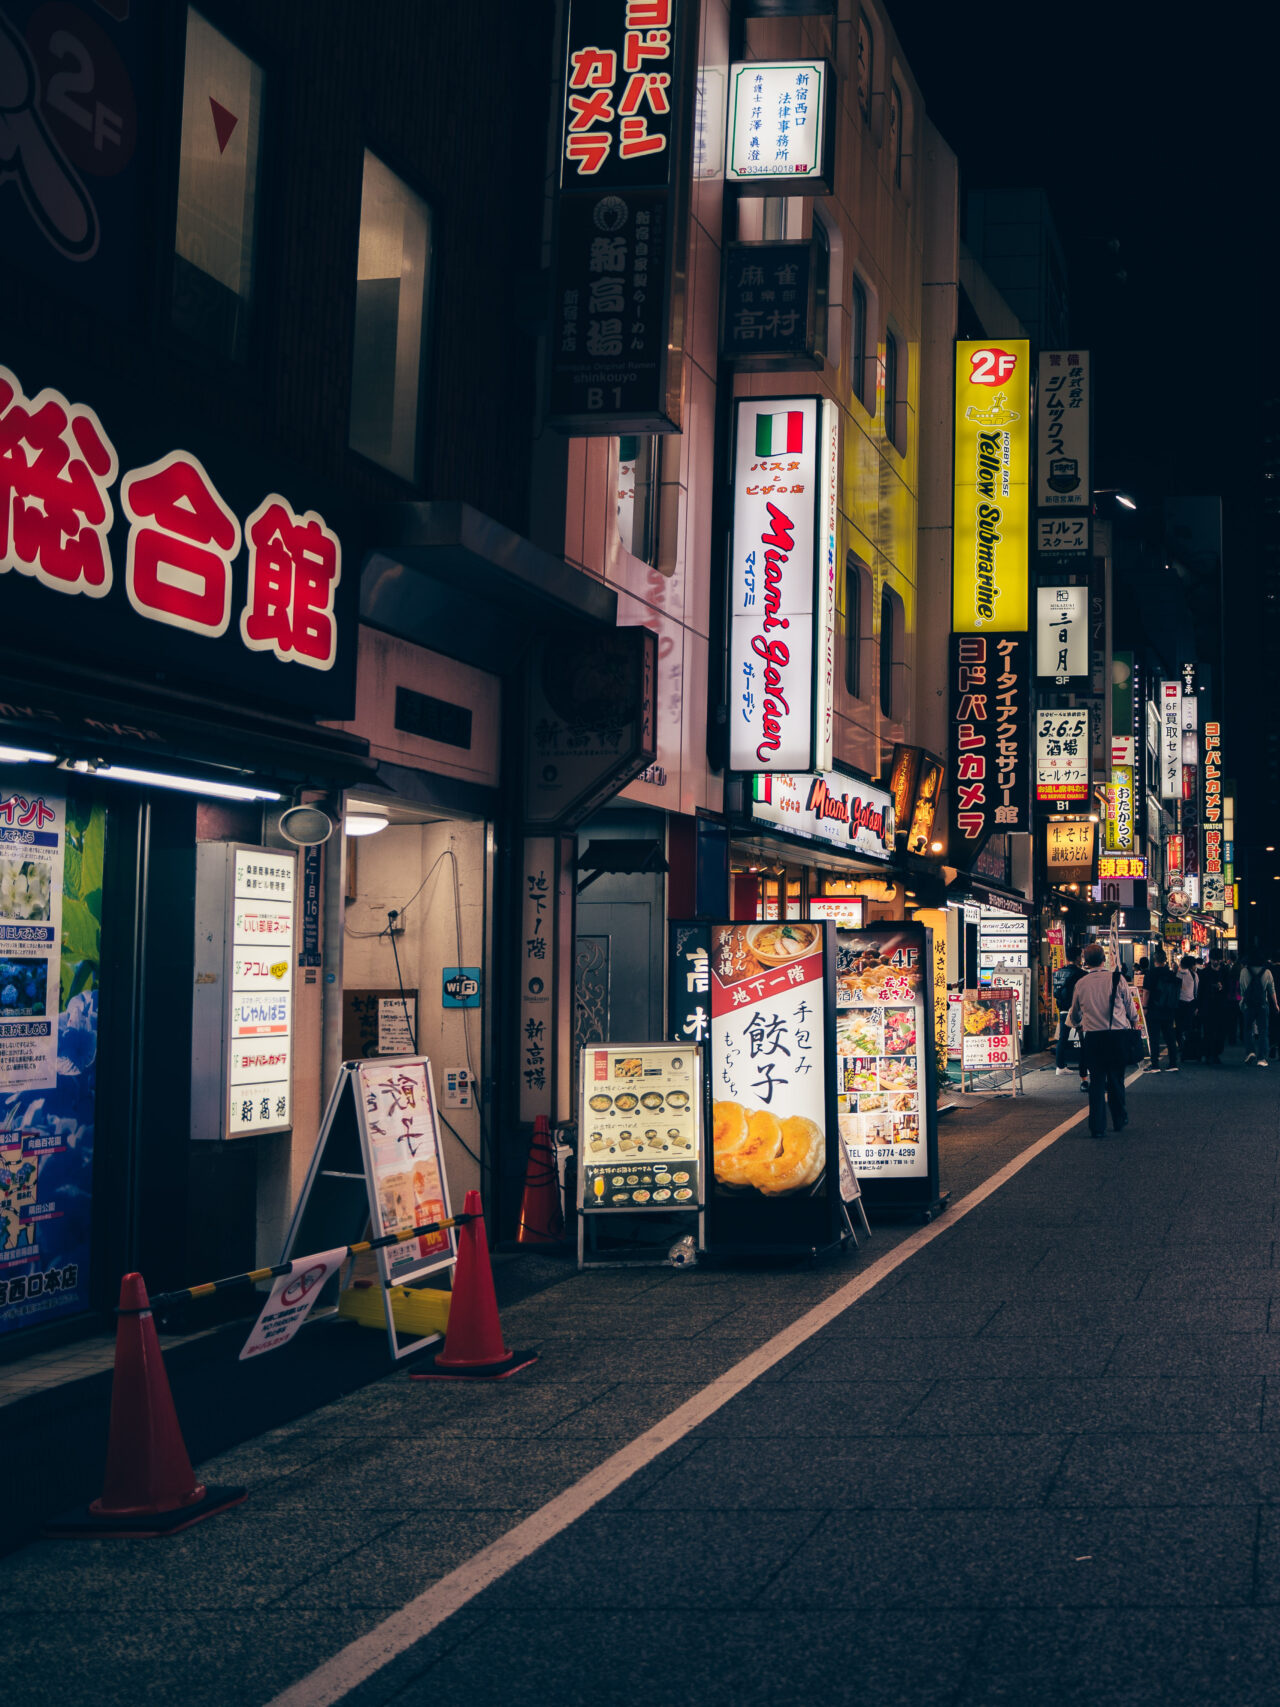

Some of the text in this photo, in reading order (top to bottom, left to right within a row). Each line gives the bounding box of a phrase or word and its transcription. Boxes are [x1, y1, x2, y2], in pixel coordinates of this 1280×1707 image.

[566, 46, 617, 175] カメラ
[795, 73, 809, 126] 新宿西口
[775, 92, 791, 161] 法律事務所
[747, 165, 794, 173] 3344-0018
[737, 263, 800, 288] 麻雀
[733, 309, 800, 341] 高村
[971, 348, 1017, 384] 2F
[1049, 354, 1080, 366] 警備
[1068, 367, 1084, 409] 株式会社
[1045, 376, 1067, 455] シムックス
[751, 461, 800, 471] パスタ
[746, 484, 804, 495] ピザの店
[0, 364, 341, 671] 総合館
[975, 430, 1002, 622] Yellow Submarine
[1041, 521, 1084, 535] ゴルフ
[1043, 538, 1084, 547] スクール
[761, 501, 795, 633] Miami
[743, 551, 756, 723] マイアミ ガーデン
[1049, 613, 1073, 672] 三日月
[1055, 676, 1070, 685] 3F
[956, 636, 988, 840] ヨドバシカメラ
[995, 638, 1019, 825] ケータイアクセサリー館
[1047, 739, 1078, 756] 酒場
[1166, 713, 1178, 793] 買取センター
[1204, 722, 1221, 822] ヨドバシカメラ
[806, 777, 849, 824] Miami
[1057, 801, 1069, 811] B1
[1117, 787, 1131, 848] おたからや
[1053, 826, 1089, 842] 生そば
[1052, 846, 1088, 862] 讃岐うどん
[1098, 858, 1144, 878] 頭買取
[1207, 831, 1222, 873] 時計館
[306, 900, 318, 915] 16
[243, 920, 290, 933] いい部屋ネット
[735, 931, 747, 972] らーめん
[891, 948, 918, 968] 4F
[243, 962, 269, 976] アコム
[731, 964, 805, 1006] 地下一階
[884, 976, 909, 988] 炭火
[878, 988, 916, 1001] 焼き鳥
[793, 1000, 813, 1075] 手包み
[987, 1037, 1008, 1048] 199
[242, 1053, 287, 1068] ヨドバシカメラ
[721, 1032, 741, 1097] もっちもち
[743, 1011, 791, 1105] 餃子
[987, 1052, 1008, 1063] 180
[849, 1148, 916, 1158] TEL 03-6774-4299
